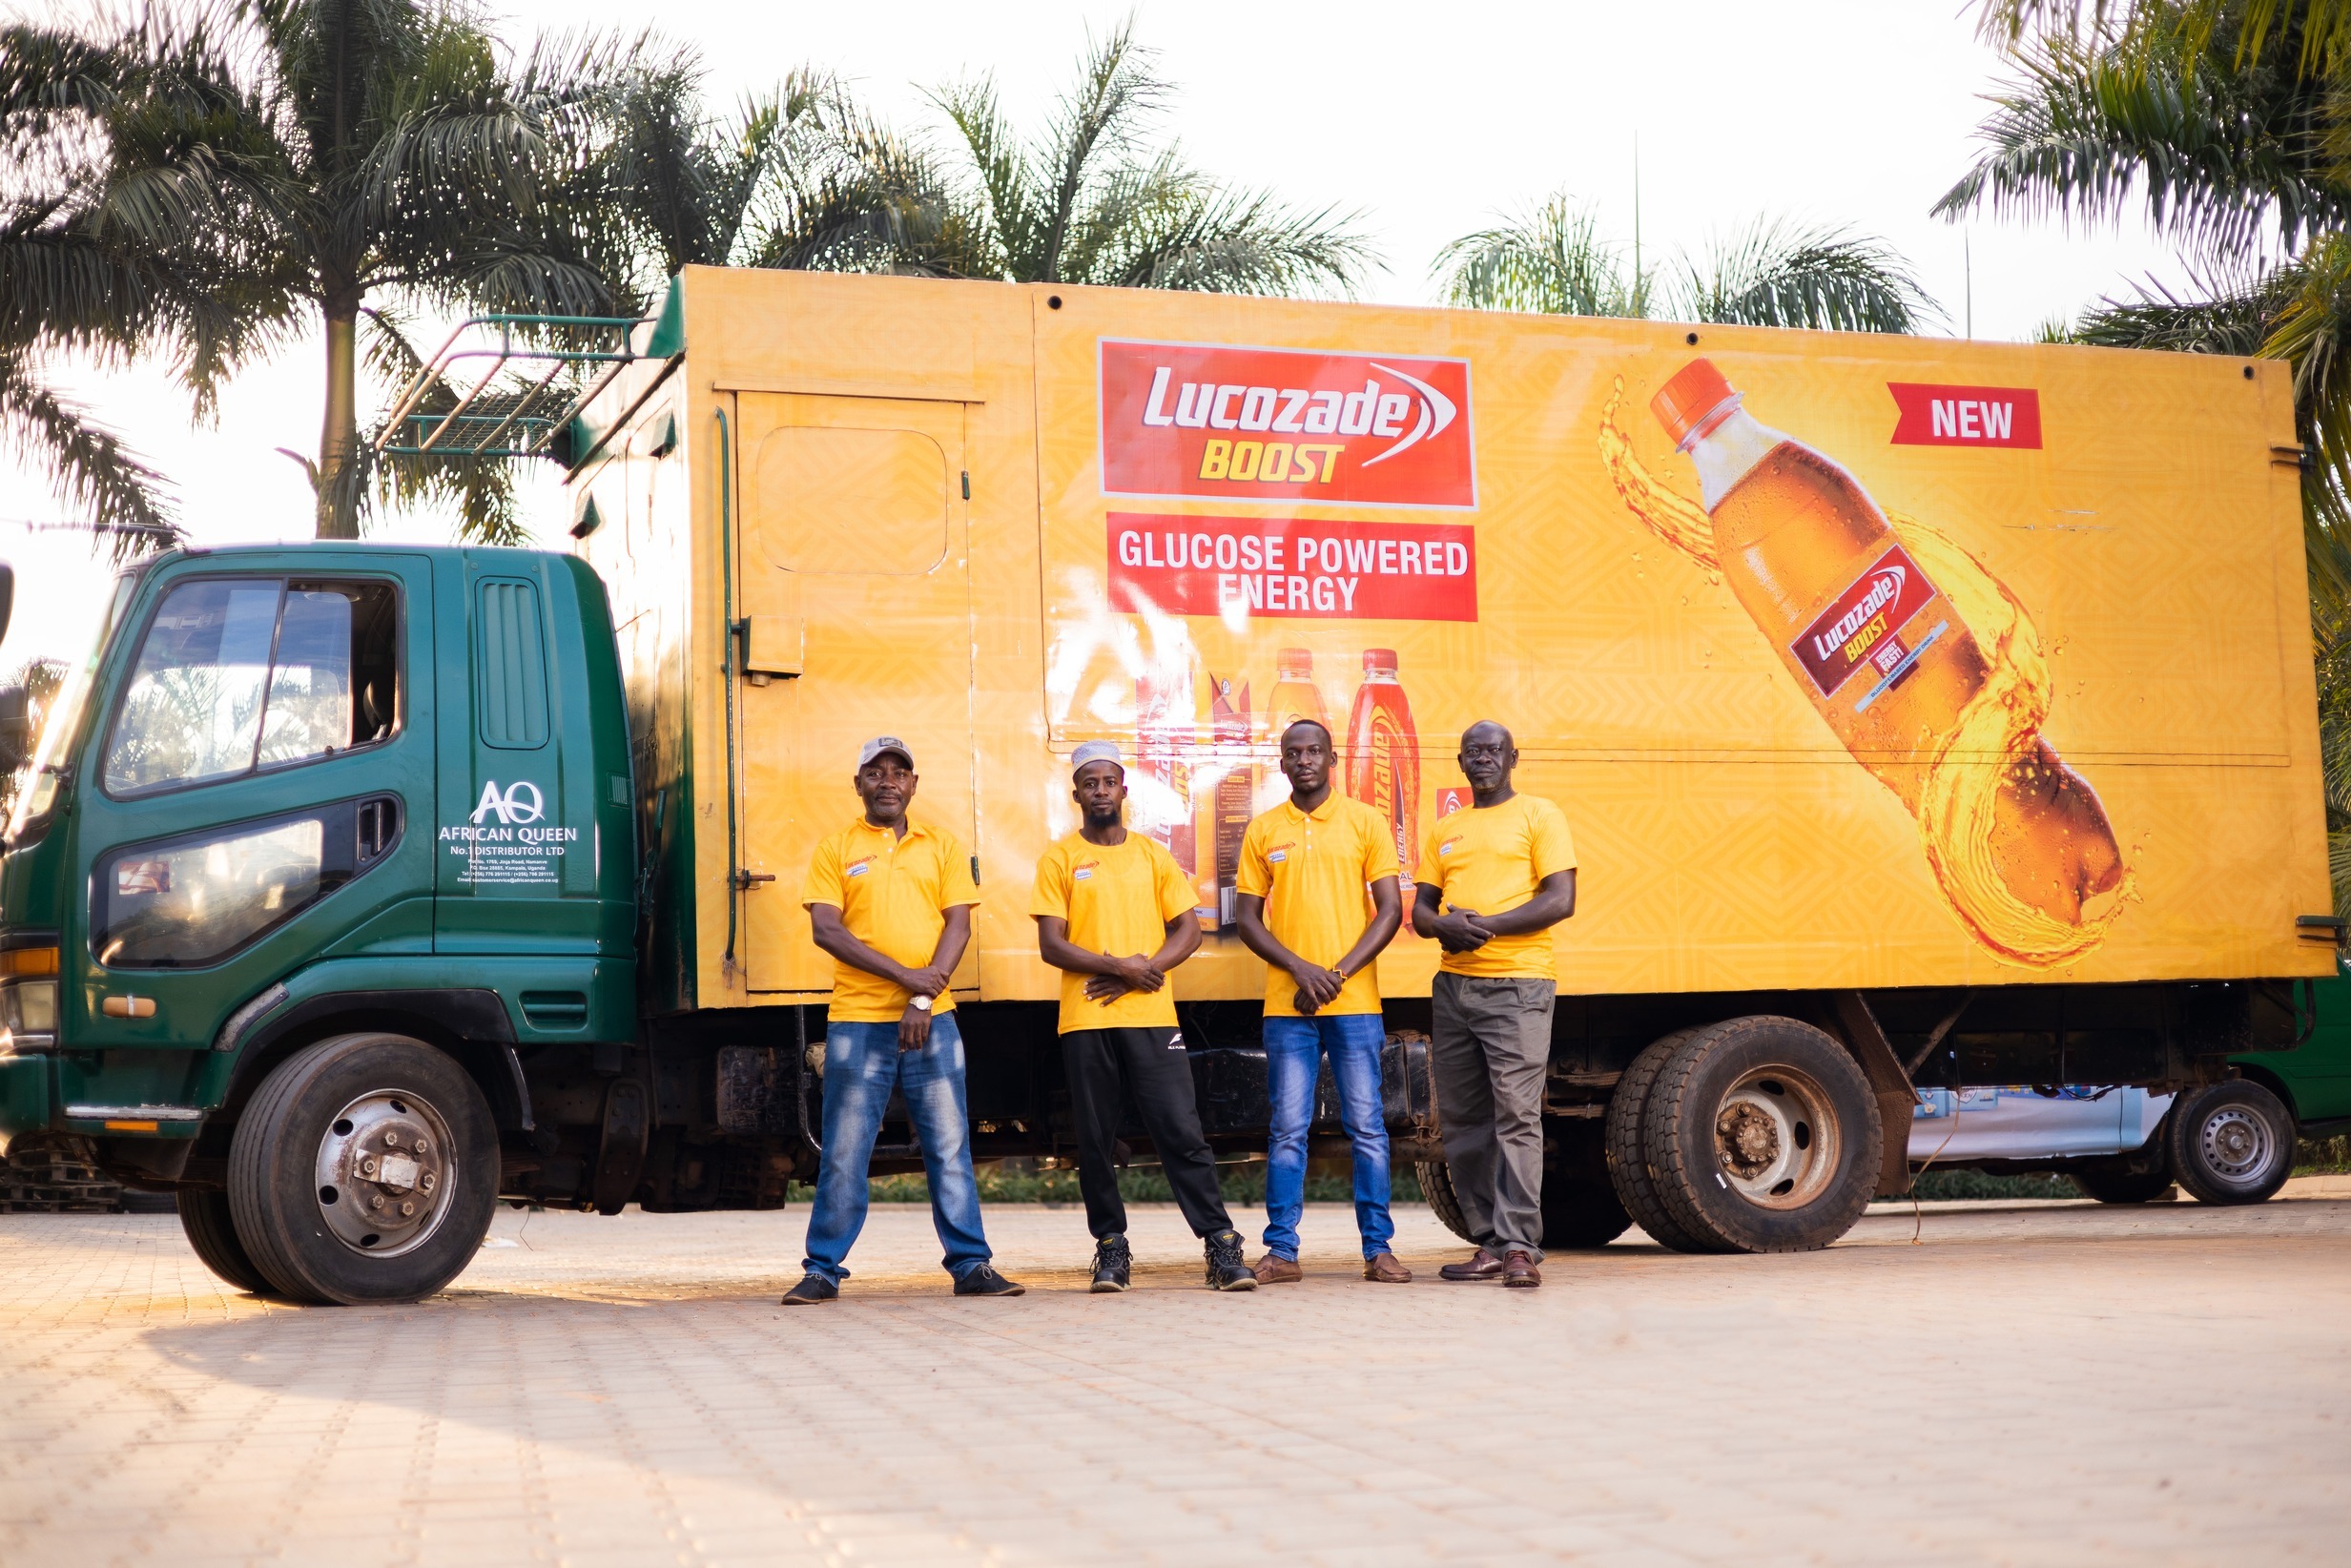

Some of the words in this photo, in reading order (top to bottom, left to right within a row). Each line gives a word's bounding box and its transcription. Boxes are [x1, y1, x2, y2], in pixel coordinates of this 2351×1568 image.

[1143, 366, 1410, 437] Lucozade
[1931, 399, 2013, 440] NEW
[1199, 439, 1345, 484] BOOST
[1118, 530, 1284, 571] GLUCOSE
[1298, 538, 1469, 577] POWERED
[1219, 574, 1359, 611] ENERGY
[1813, 574, 1896, 662] Lucozade
[1844, 611, 1888, 664] BOOST
[1875, 640, 1898, 664] ENERGY
[1880, 647, 1905, 671] FAST!
[469, 780, 545, 824] AQ
[439, 827, 512, 841] AFRICAN
[518, 827, 577, 845] QUEEN
[475, 846, 543, 856] DISTRIBUTOR
[546, 846, 565, 856] LTD
[1396, 822, 1406, 864] ENERGY
